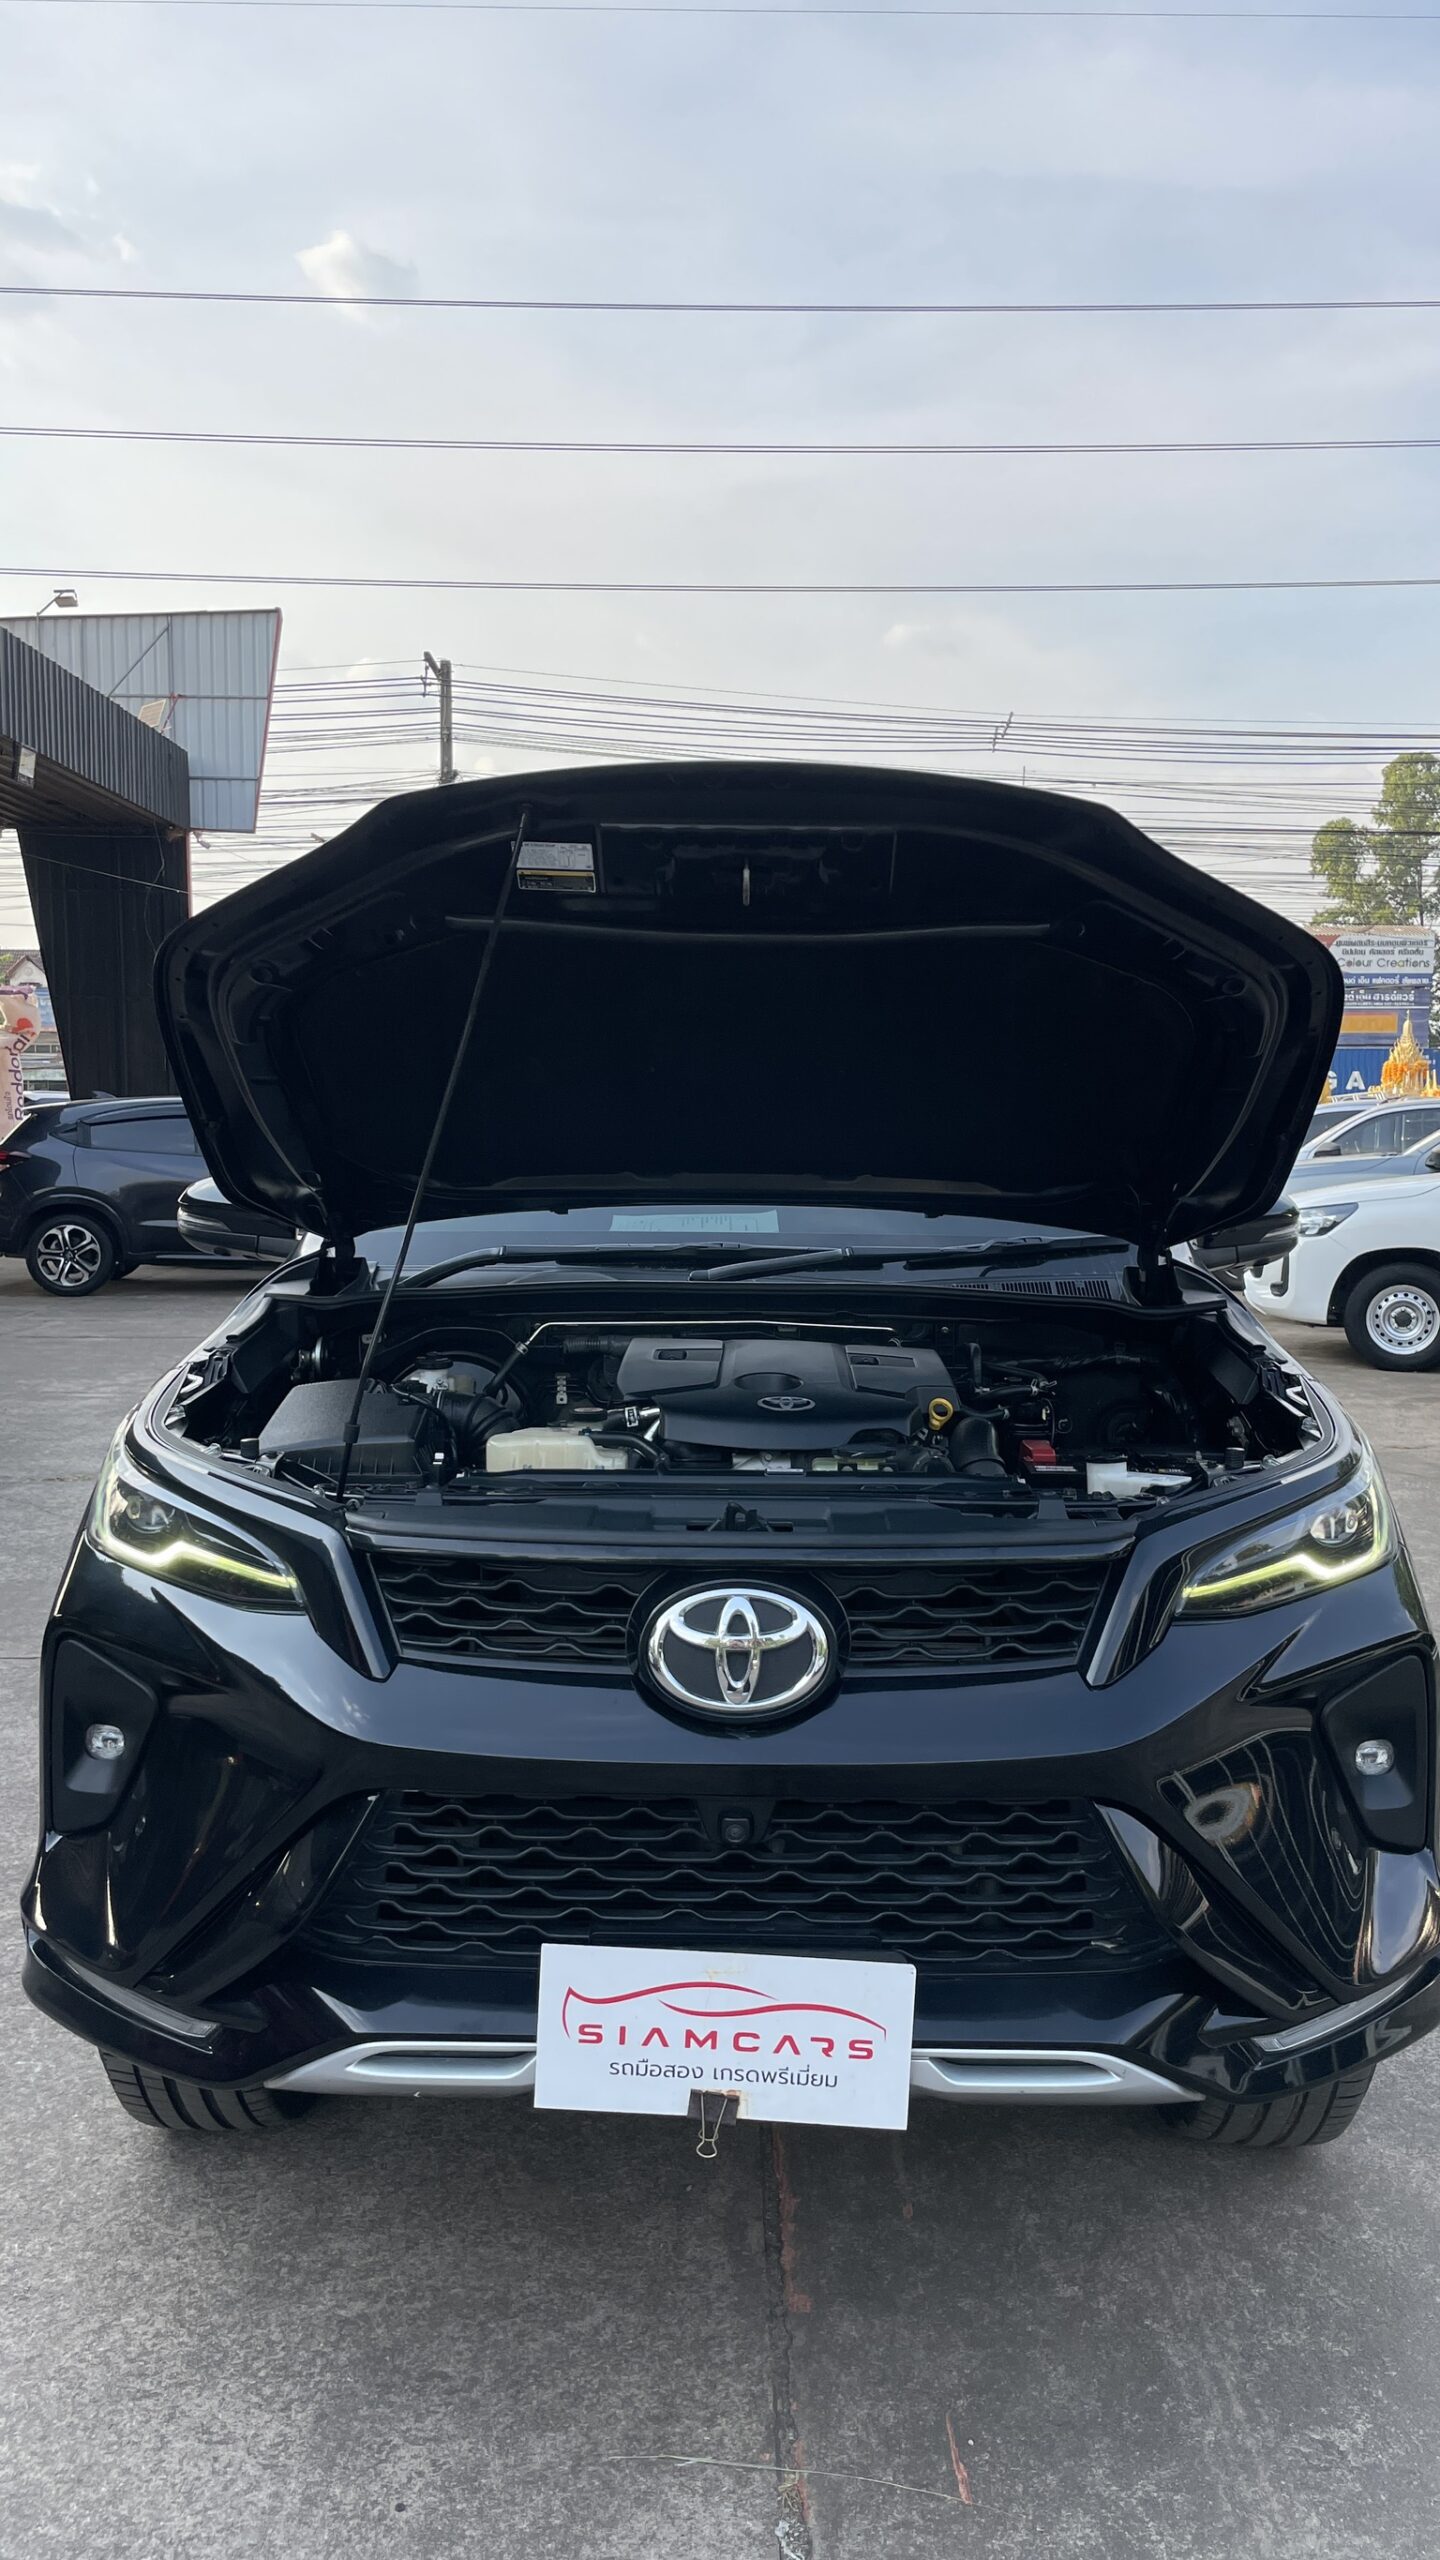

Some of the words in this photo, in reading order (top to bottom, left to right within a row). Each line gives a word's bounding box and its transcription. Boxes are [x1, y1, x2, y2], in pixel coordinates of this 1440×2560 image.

[1338, 957, 1372, 968] Colour
[1377, 957, 1430, 968] Creations
[578, 2024, 873, 2060] SIAMCARS
[609, 2057, 703, 2080] รถมือสอง
[713, 2063, 838, 2088] เกรดพรีเมี่ยม
